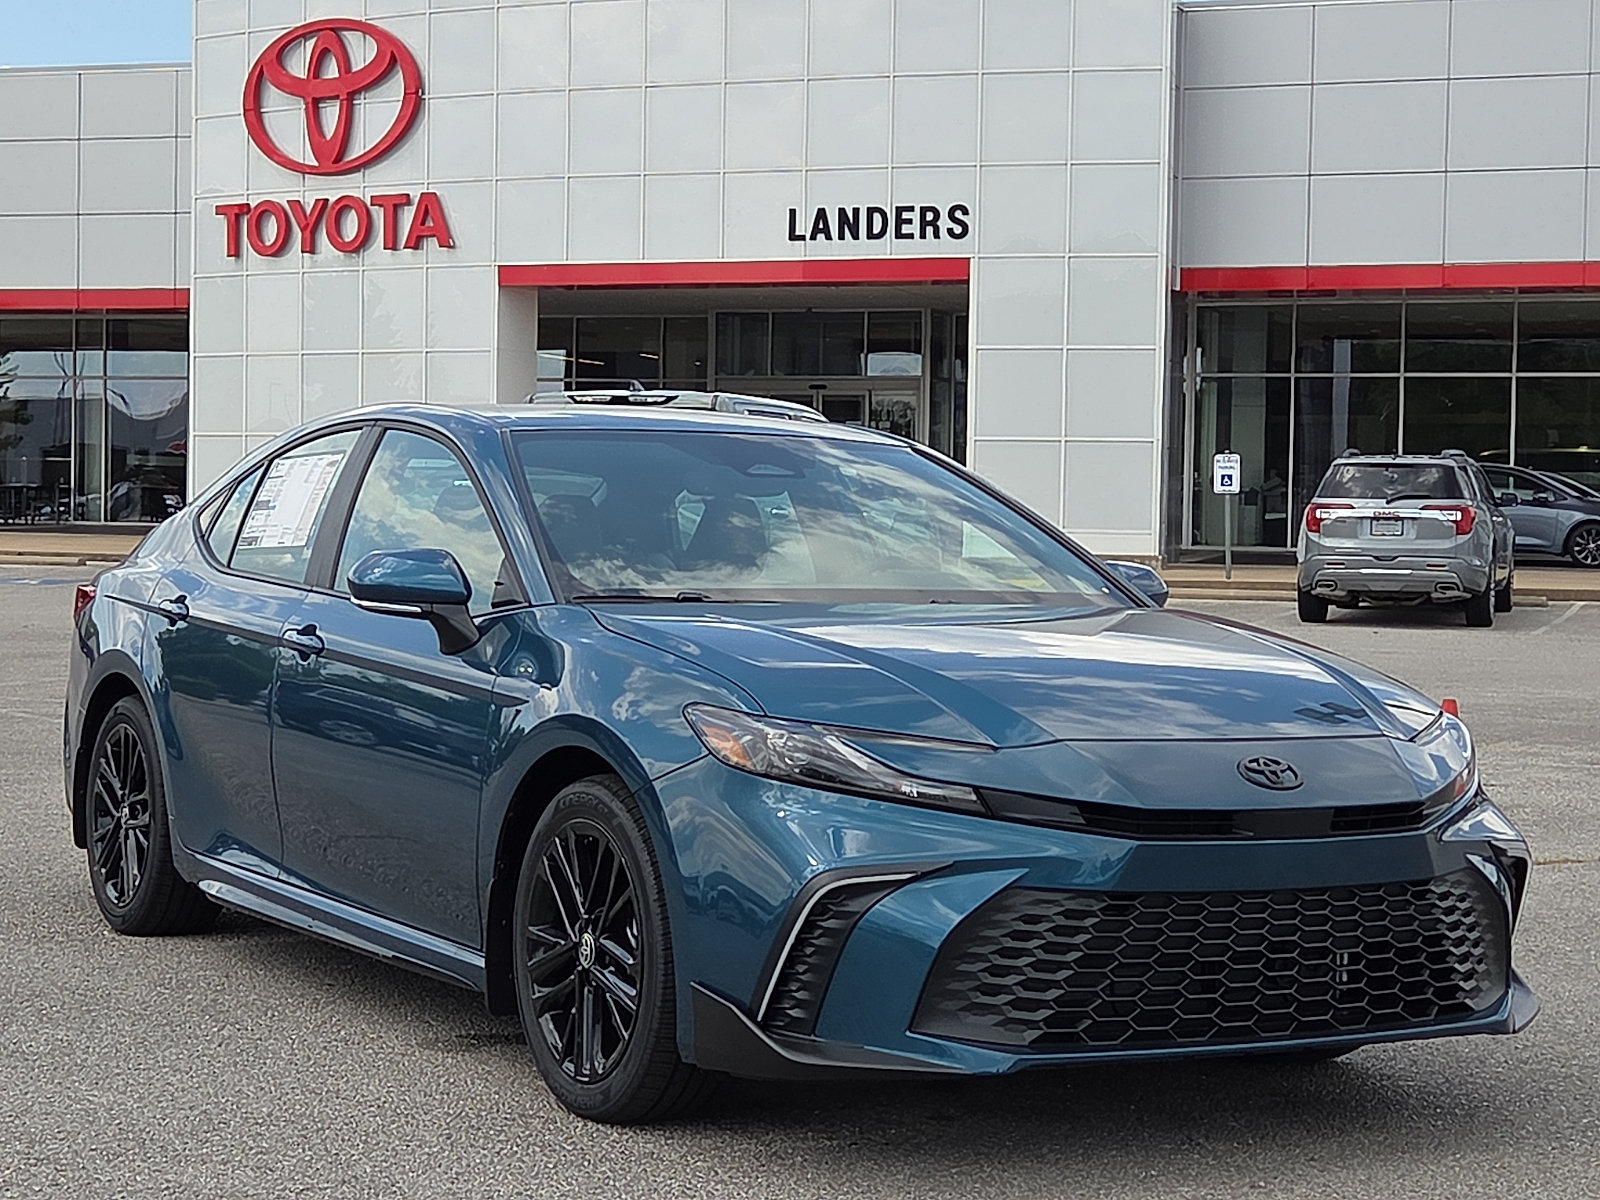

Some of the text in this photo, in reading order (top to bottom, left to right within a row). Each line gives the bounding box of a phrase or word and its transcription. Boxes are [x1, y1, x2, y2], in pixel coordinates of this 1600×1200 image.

[215, 192, 455, 258] TOYOTA
[787, 203, 970, 242] LANDERS
[1373, 510, 1401, 518] GMC
